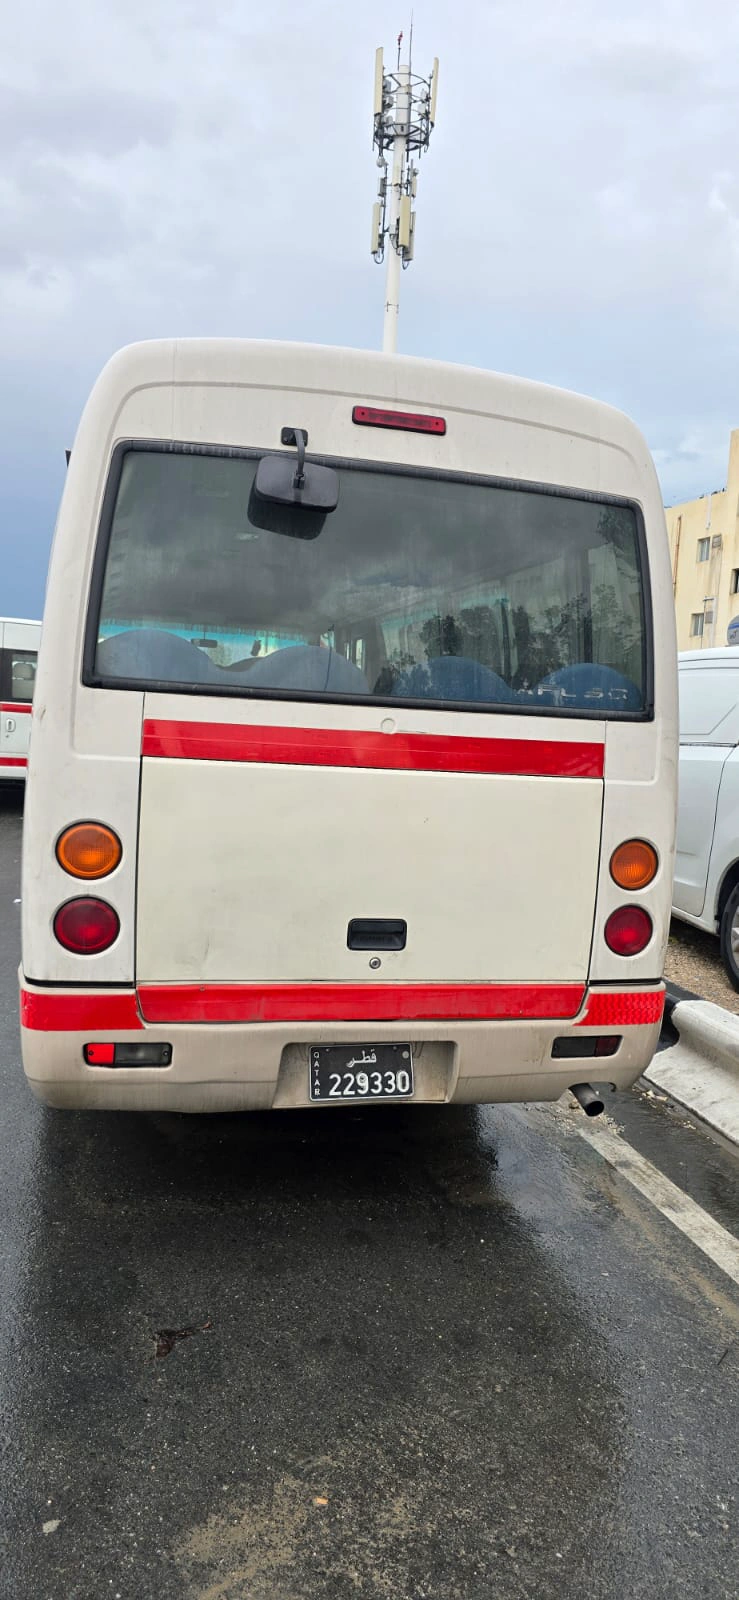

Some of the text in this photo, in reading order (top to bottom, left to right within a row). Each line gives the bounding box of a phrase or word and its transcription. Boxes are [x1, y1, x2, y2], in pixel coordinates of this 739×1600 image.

[346, 1048, 377, 1068] قطر
[313, 1051, 321, 1096] QATAR
[328, 1070, 410, 1096] 229330
